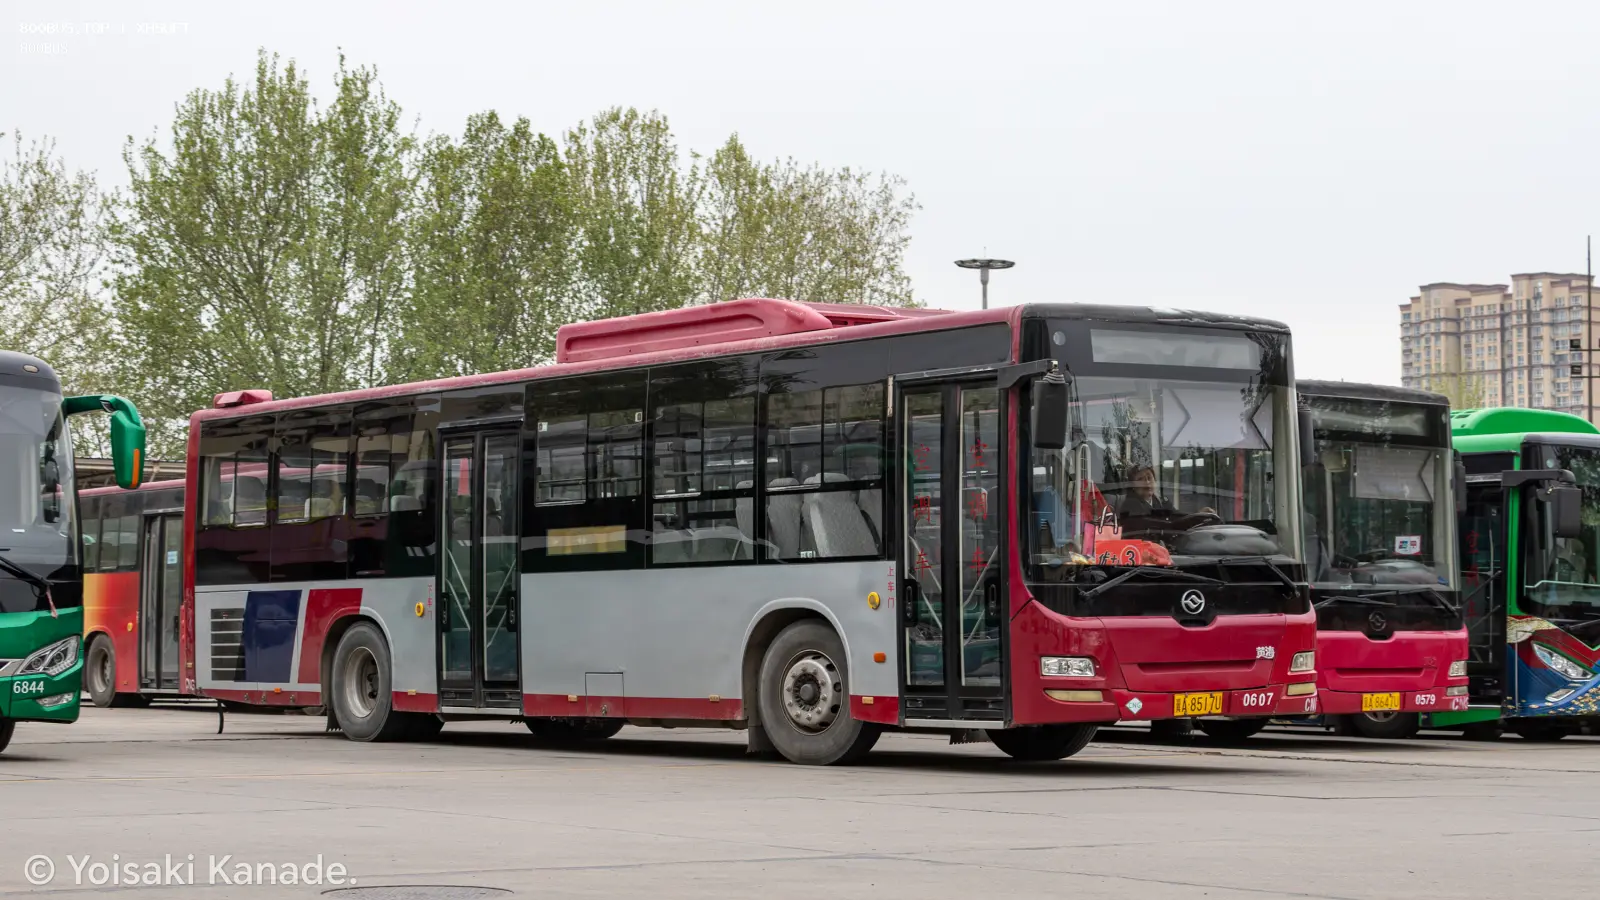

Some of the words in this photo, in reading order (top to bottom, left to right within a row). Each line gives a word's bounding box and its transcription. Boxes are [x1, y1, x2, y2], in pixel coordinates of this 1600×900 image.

[912, 443, 931, 579] 空调车
[967, 438, 988, 578] 空调车
[887, 567, 895, 608] 上车门
[13, 680, 44, 694] 6844
[1243, 692, 1273, 706] 0607
[1415, 694, 1435, 705] 0579
